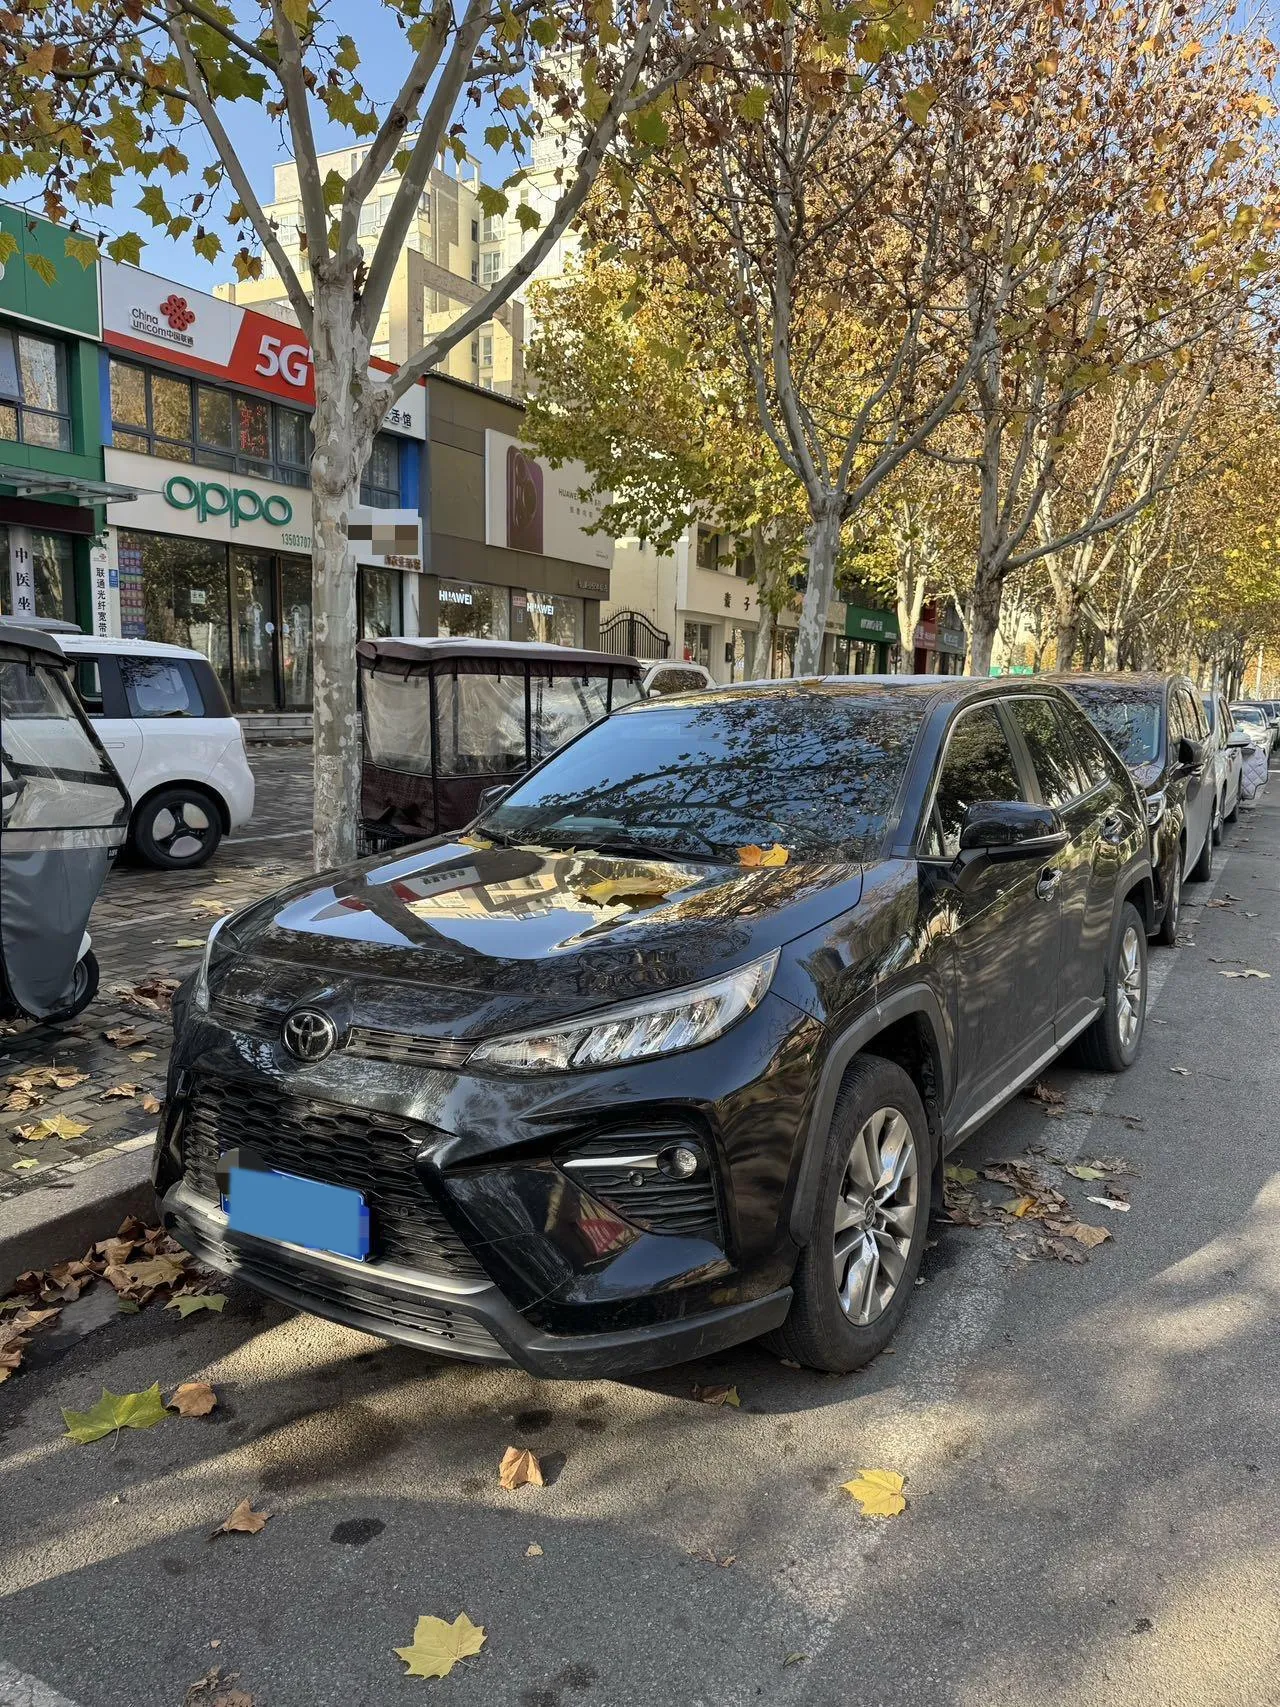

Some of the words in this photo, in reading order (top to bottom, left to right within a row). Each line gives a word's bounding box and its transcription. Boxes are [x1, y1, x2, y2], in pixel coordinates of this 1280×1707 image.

[131, 308, 159, 325] China
[133, 320, 168, 337] unicom
[255, 334, 314, 387] 5G
[384, 407, 412, 427] 活馆
[281, 533, 313, 549] 13503707
[15, 547, 32, 612] 中医坐
[95, 567, 109, 638] 联通光纤宽带
[438, 589, 473, 606] HUAWEI
[526, 601, 555, 616] HUAWEI
